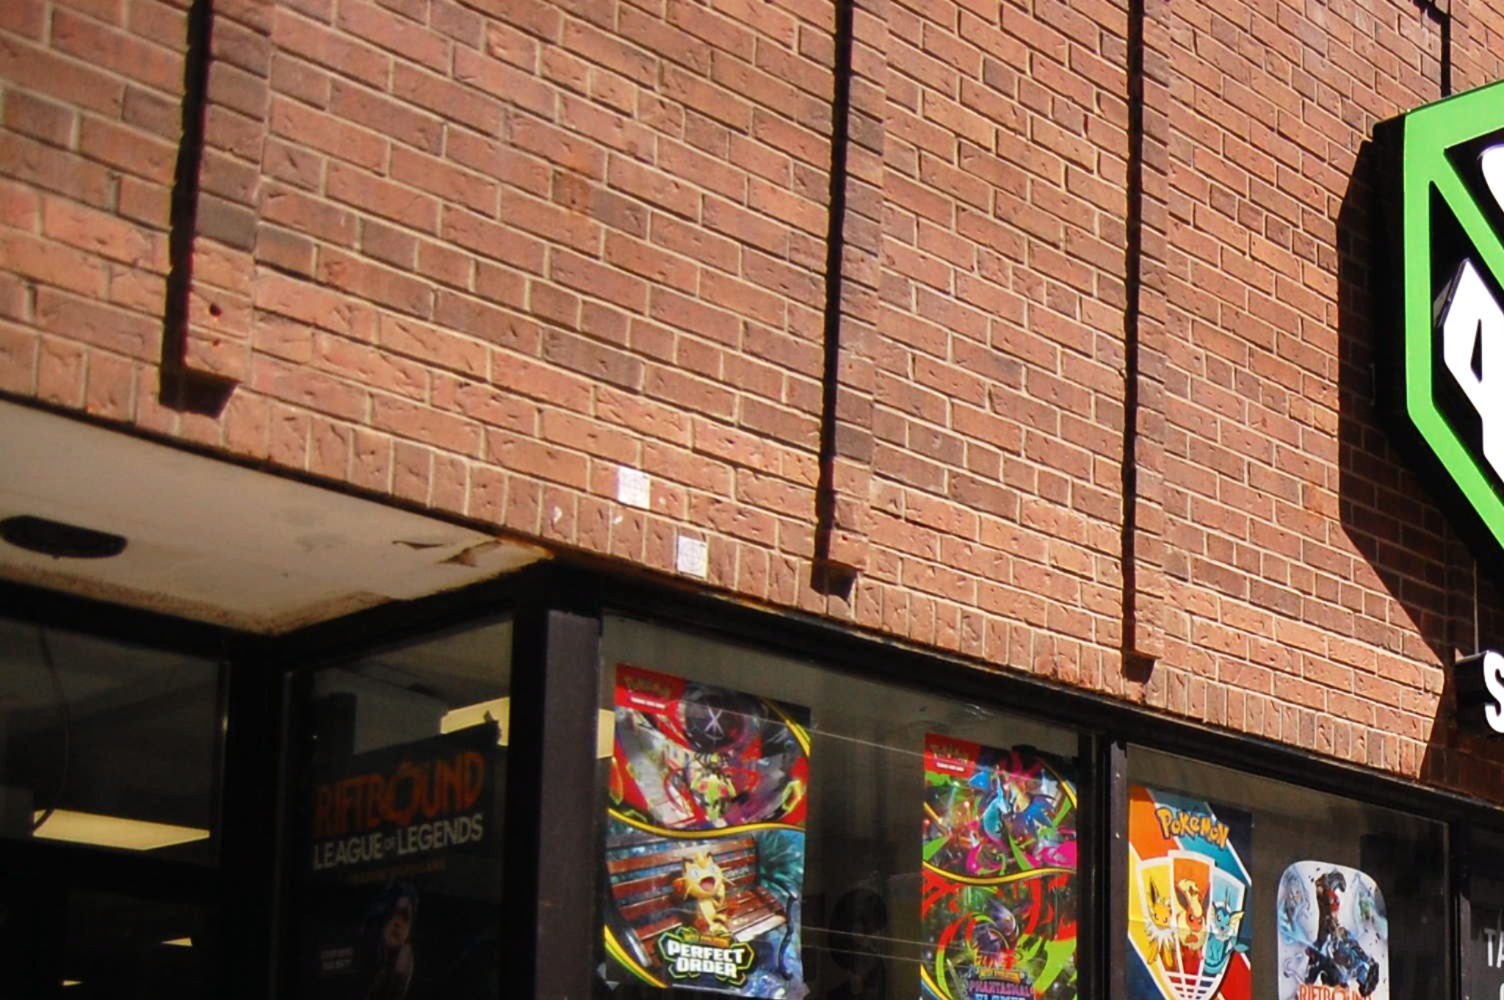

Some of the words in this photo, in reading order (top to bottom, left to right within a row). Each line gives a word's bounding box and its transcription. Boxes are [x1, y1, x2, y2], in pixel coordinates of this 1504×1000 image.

[315, 751, 485, 838] RIFTBOUND
[313, 831, 384, 872] LEAGUE
[396, 812, 484, 856] LEGENDS
[665, 943, 746, 968] PERFECT
[675, 956, 738, 980] ORDER
